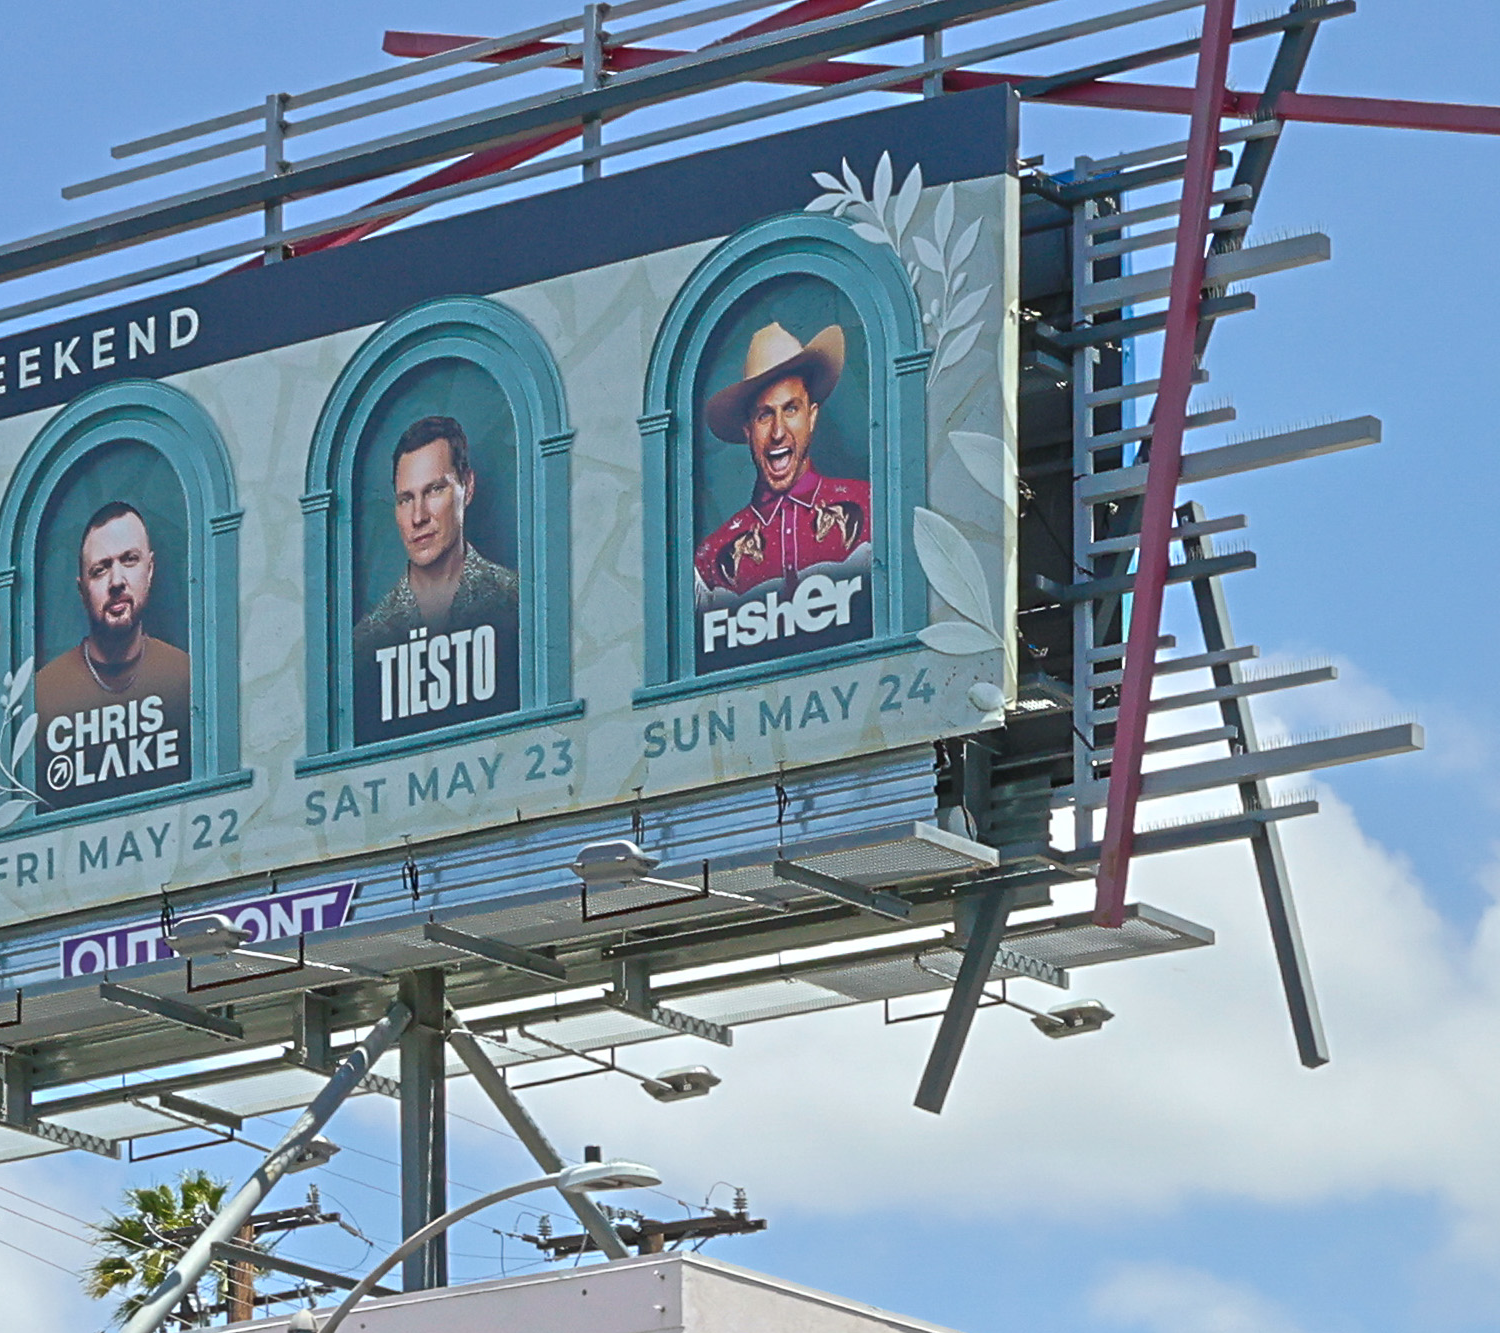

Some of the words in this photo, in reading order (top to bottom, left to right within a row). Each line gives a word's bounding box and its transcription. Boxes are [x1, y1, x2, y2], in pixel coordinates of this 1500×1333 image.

[376, 625, 495, 722] TIËSTO
[47, 695, 163, 753] CHRIS
[644, 706, 735, 758] SUN
[759, 681, 858, 736] MAY
[879, 668, 936, 712] 24
[76, 729, 179, 786] LAKE
[306, 778, 386, 826] SAT
[408, 752, 504, 806] MAY
[525, 739, 573, 781] 23
[79, 822, 170, 874] MAY
[192, 809, 239, 851] 22
[70, 892, 338, 970] OUTONT
